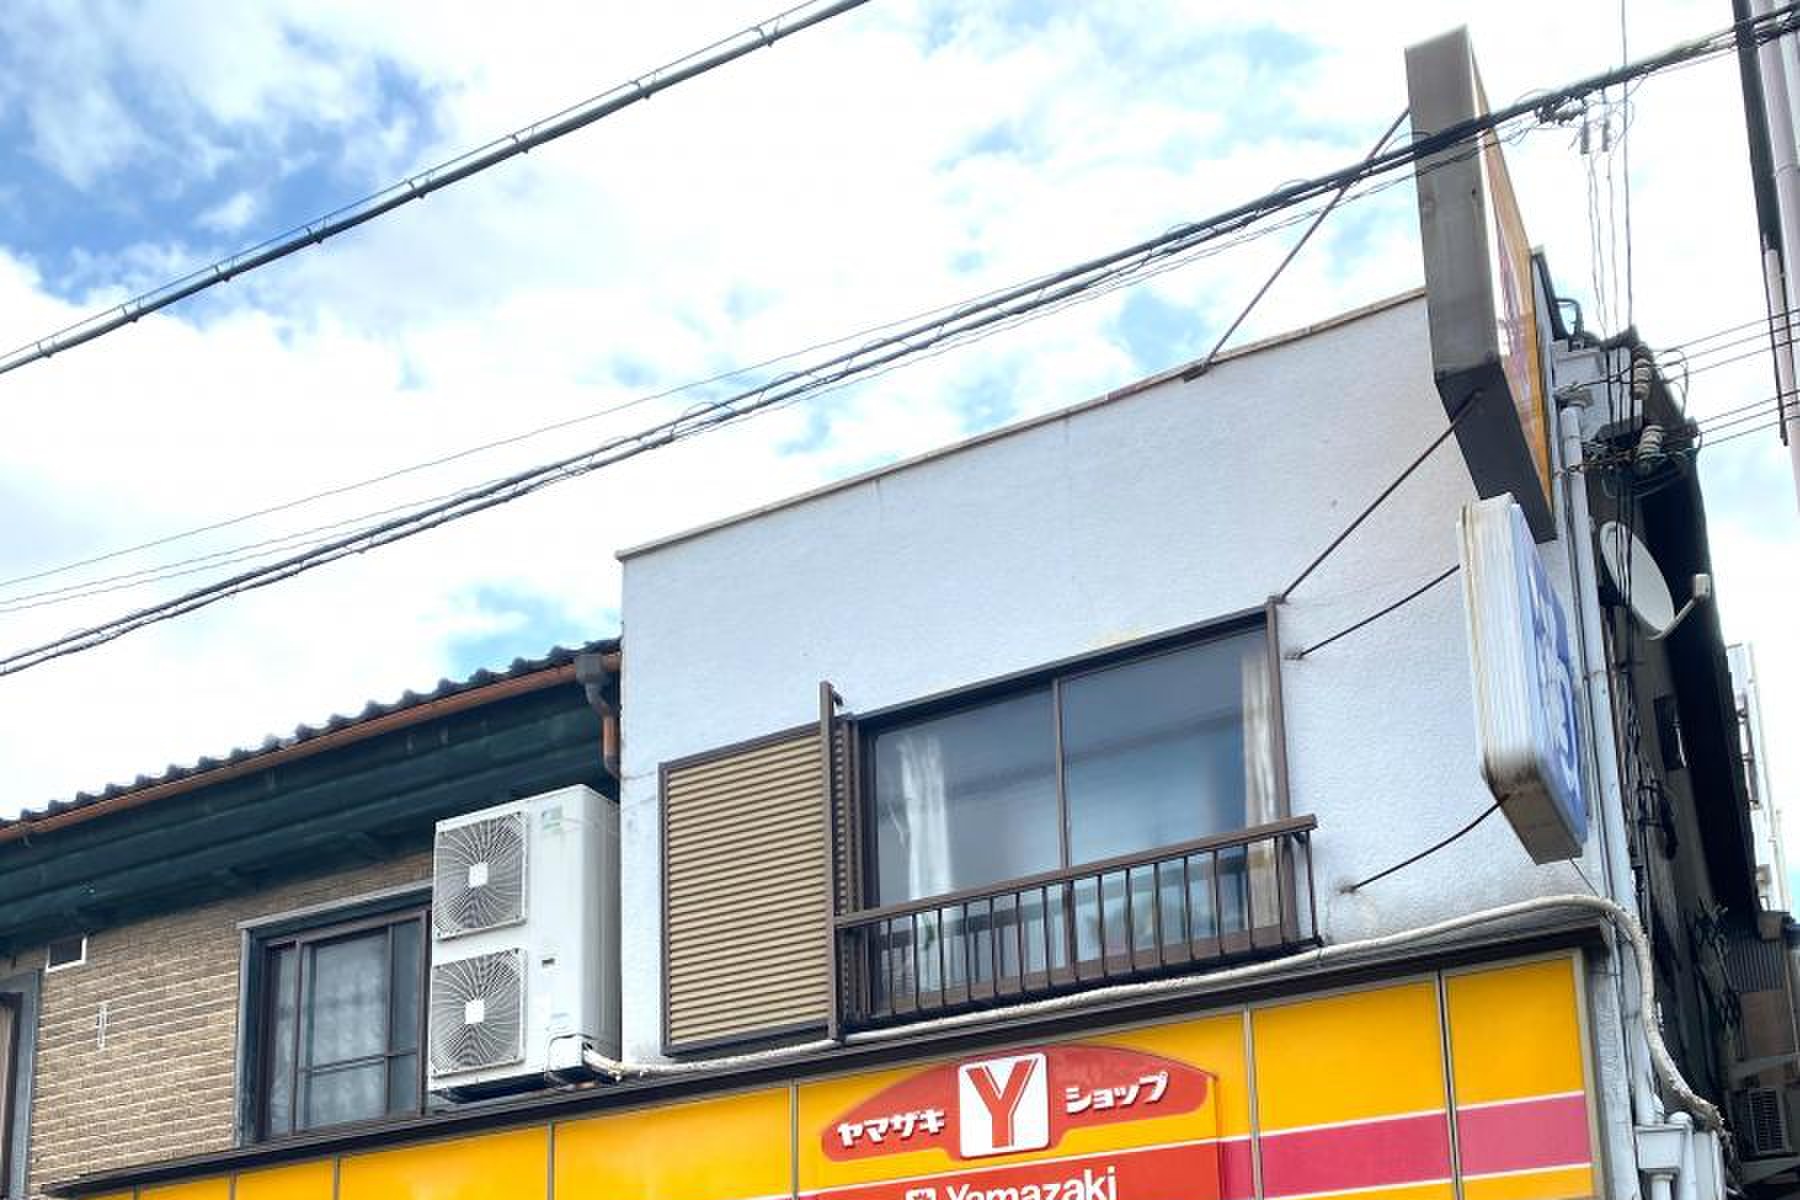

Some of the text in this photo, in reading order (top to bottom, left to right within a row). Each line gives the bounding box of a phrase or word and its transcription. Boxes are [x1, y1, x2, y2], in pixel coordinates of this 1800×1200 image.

[837, 1058, 1169, 1149] ヤマザキ Y ショップ
